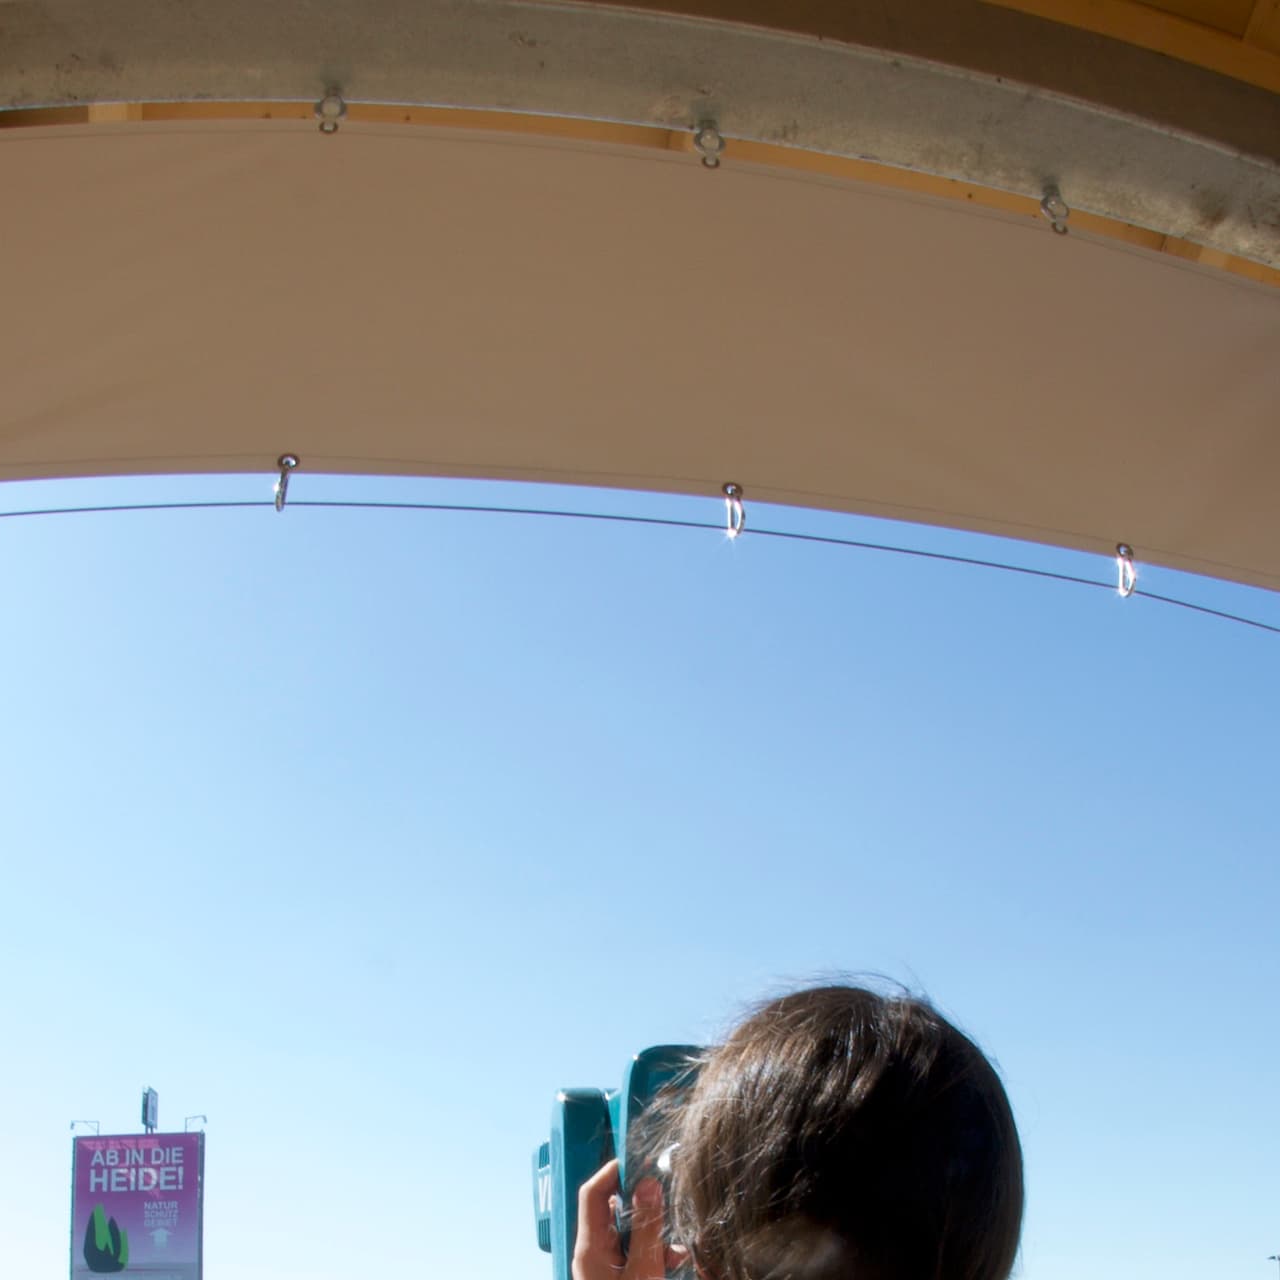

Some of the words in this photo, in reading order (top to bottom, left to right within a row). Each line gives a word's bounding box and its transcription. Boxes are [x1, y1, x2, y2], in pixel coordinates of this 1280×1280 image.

[91, 1150, 119, 1166] AB
[125, 1148, 144, 1165] IN
[151, 1147, 184, 1164] DIE
[89, 1166, 184, 1192] HEIDE!
[144, 1201, 179, 1209] NATUR
[144, 1209, 179, 1218] SCHUTZ
